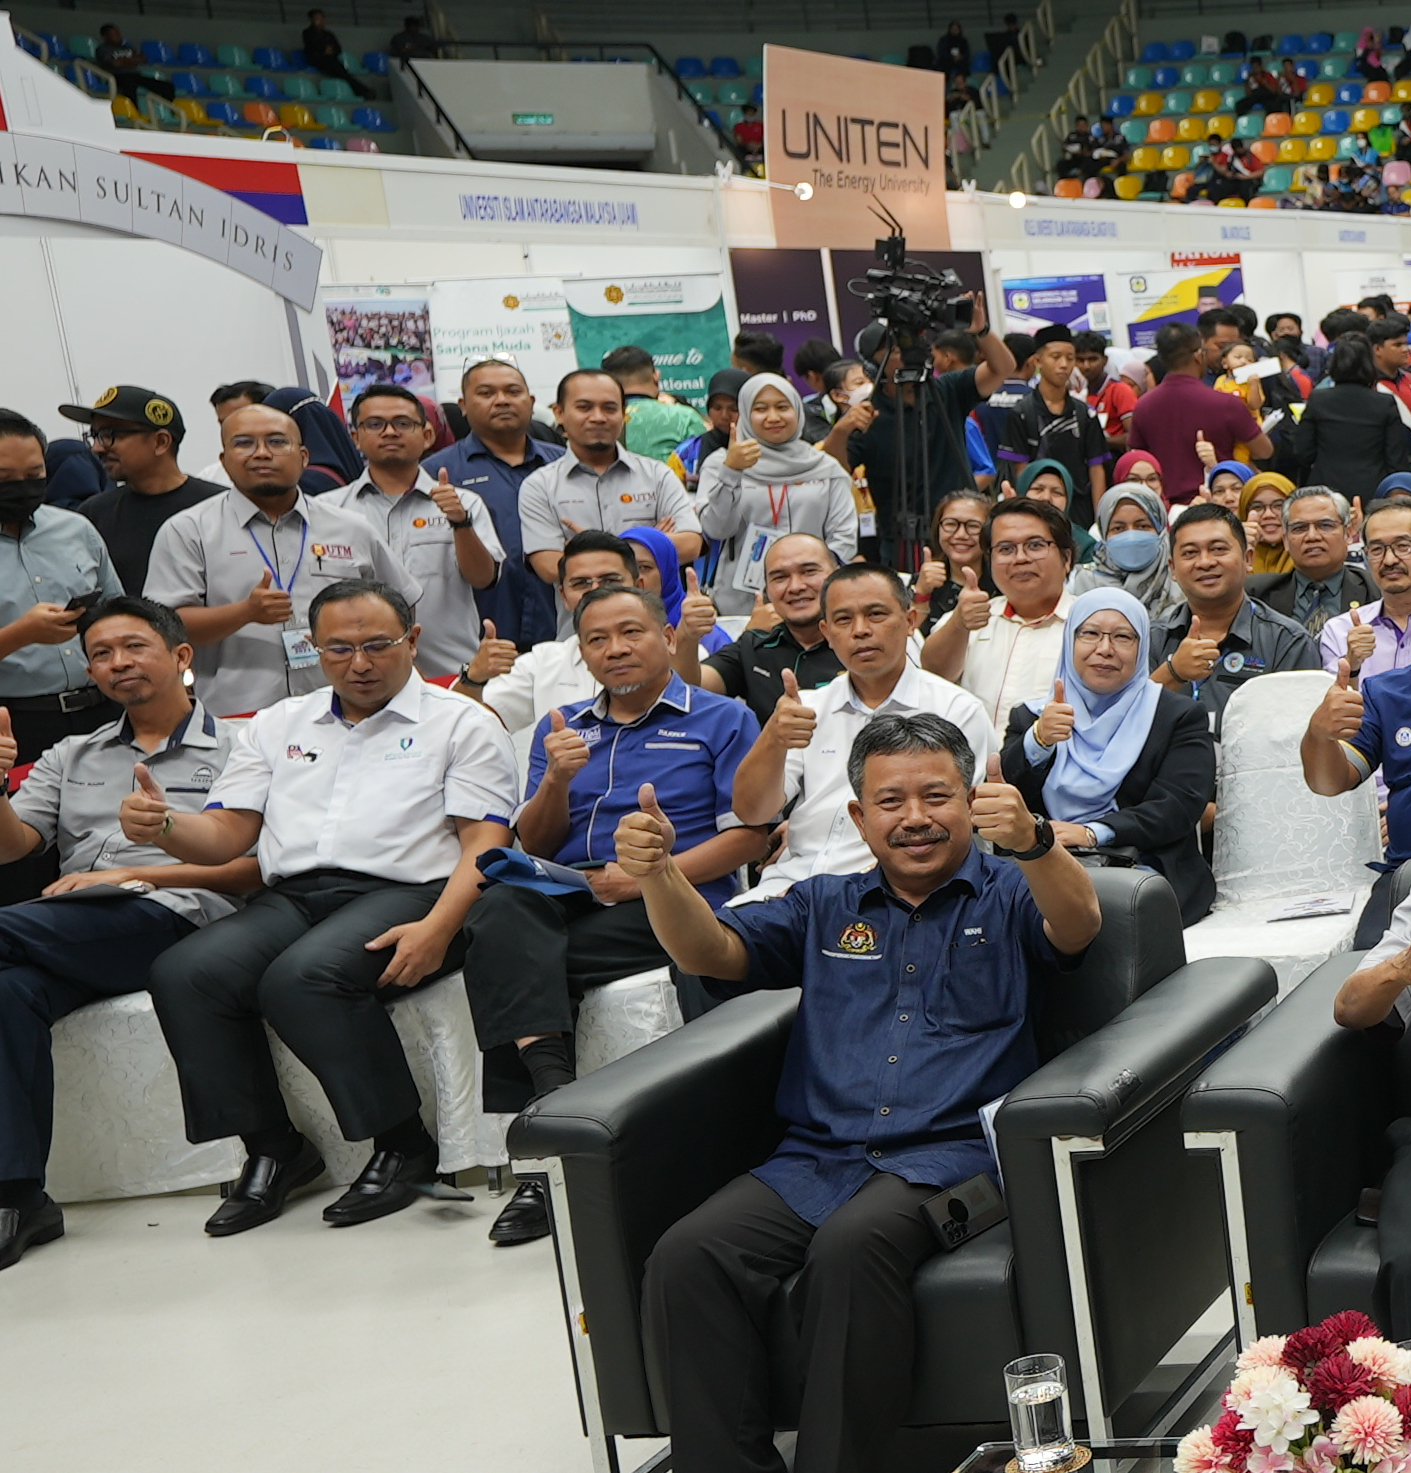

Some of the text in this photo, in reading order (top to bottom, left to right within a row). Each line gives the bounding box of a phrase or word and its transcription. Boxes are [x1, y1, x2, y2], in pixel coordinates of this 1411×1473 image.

[781, 107, 931, 171] UNITEN
[812, 168, 930, 197] The Energy University
[96, 175, 205, 229] SULTAN
[220, 217, 294, 272] IDRIS
[740, 309, 817, 325] Master PhD
[433, 323, 535, 340] Program Ijazah
[436, 339, 531, 356] Sarjana Muda
[633, 492, 656, 503] UTM
[327, 545, 352, 557] UTM
